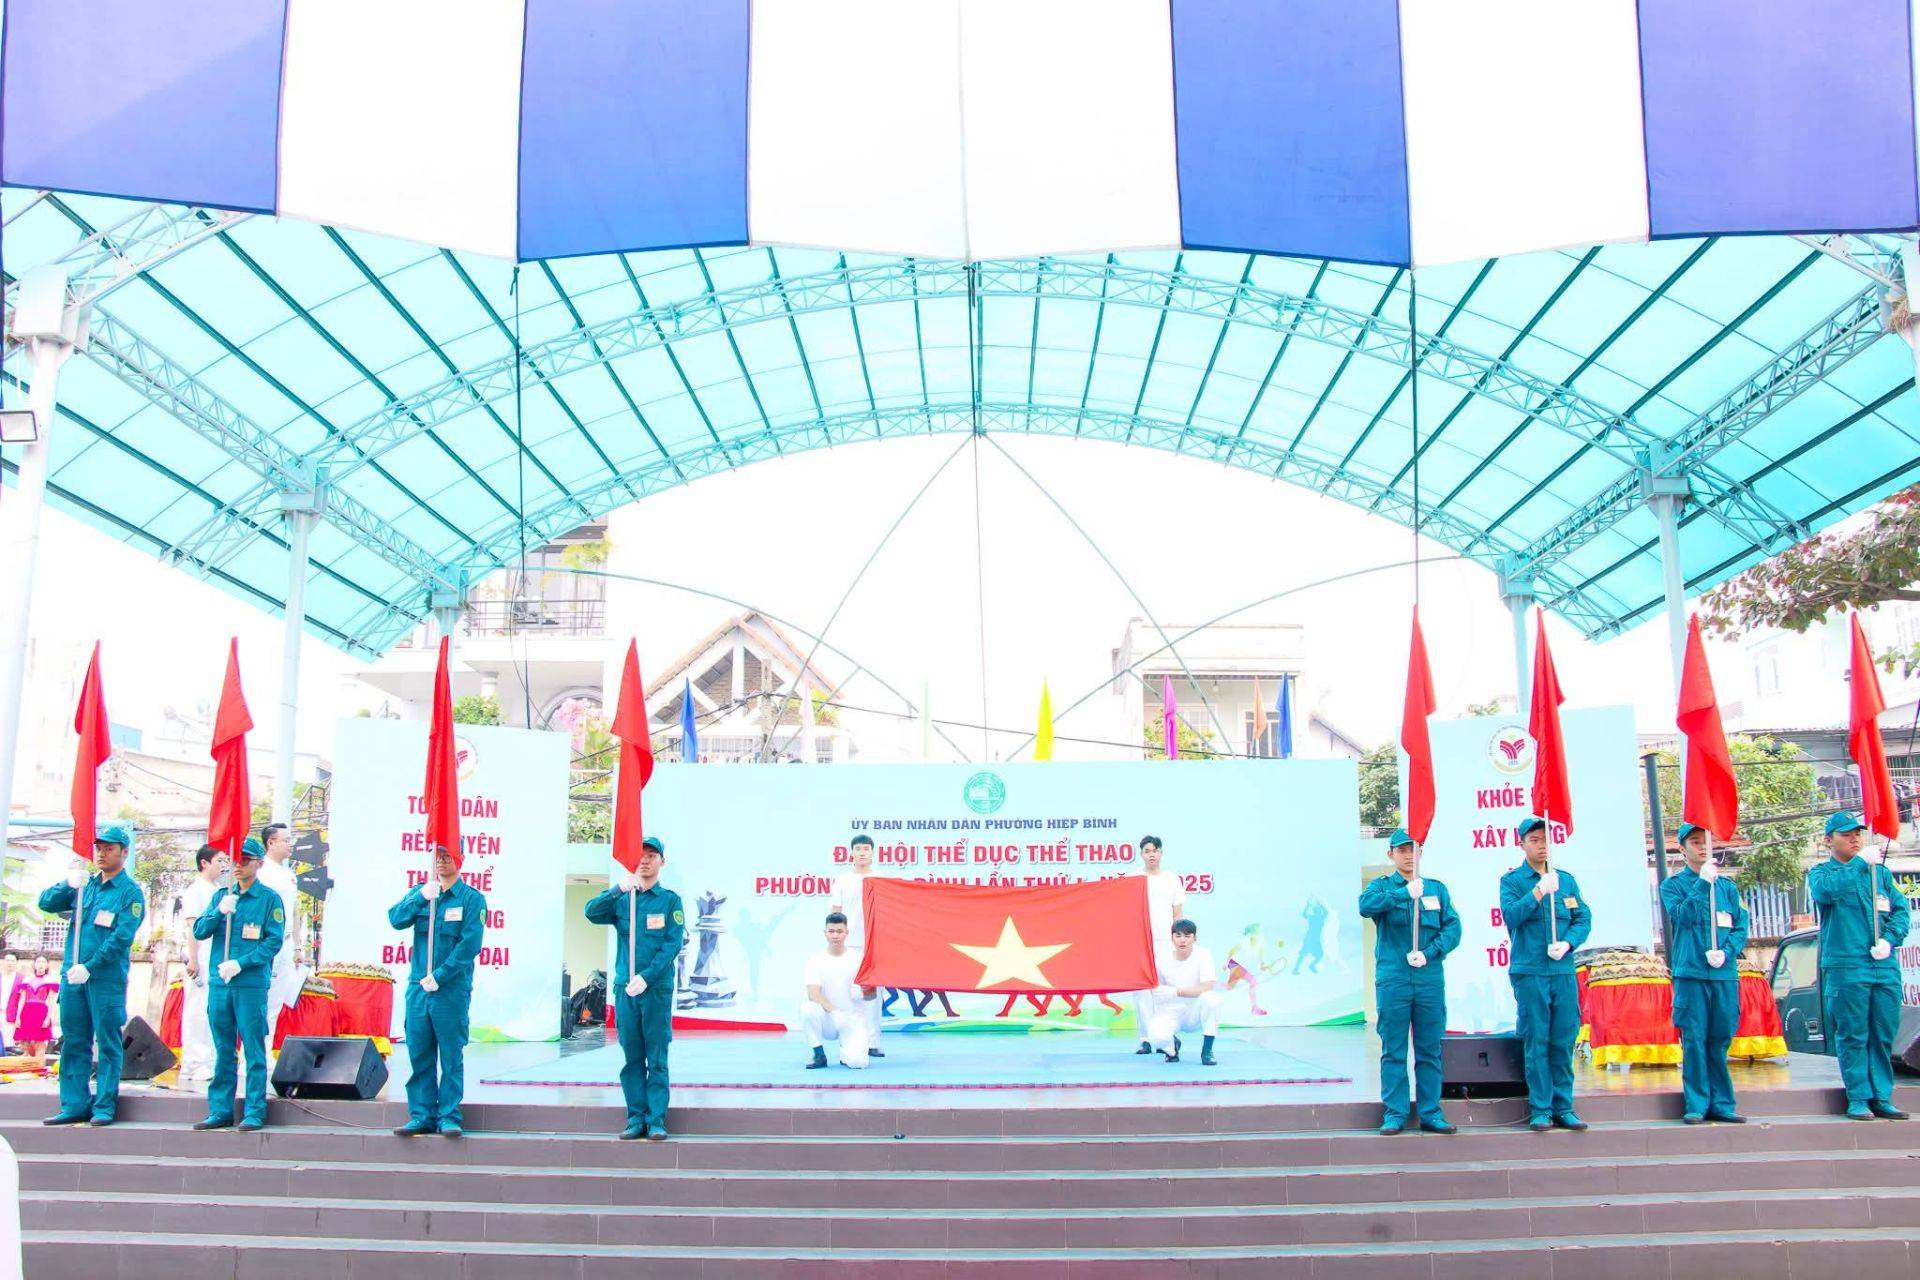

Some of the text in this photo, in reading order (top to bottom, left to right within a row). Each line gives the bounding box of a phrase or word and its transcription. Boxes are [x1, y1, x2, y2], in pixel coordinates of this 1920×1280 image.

[461, 796, 498, 818] DÂN
[1477, 781, 1525, 809] KHỎE
[873, 819, 903, 830] BAN
[906, 817, 948, 830] NHÂN
[951, 817, 981, 830] DÂN
[984, 816, 1043, 830] PHƯỜNG
[1046, 816, 1079, 830] HIỆP
[1082, 816, 1118, 829] BÌNH
[401, 829, 432, 853] RÈ
[1472, 824, 1508, 848] XÂY
[878, 841, 916, 867] HỘI
[923, 837, 968, 863] THỂ
[973, 844, 1019, 866] DỤC
[1026, 837, 1069, 862] THỂ
[1075, 843, 1134, 862] THAO
[460, 866, 492, 892] THỂ
[755, 873, 834, 895] PHƯỜN
[1178, 873, 1213, 892] 25
[480, 947, 509, 970] ĐẠI
[1486, 939, 1509, 967] TỔ
